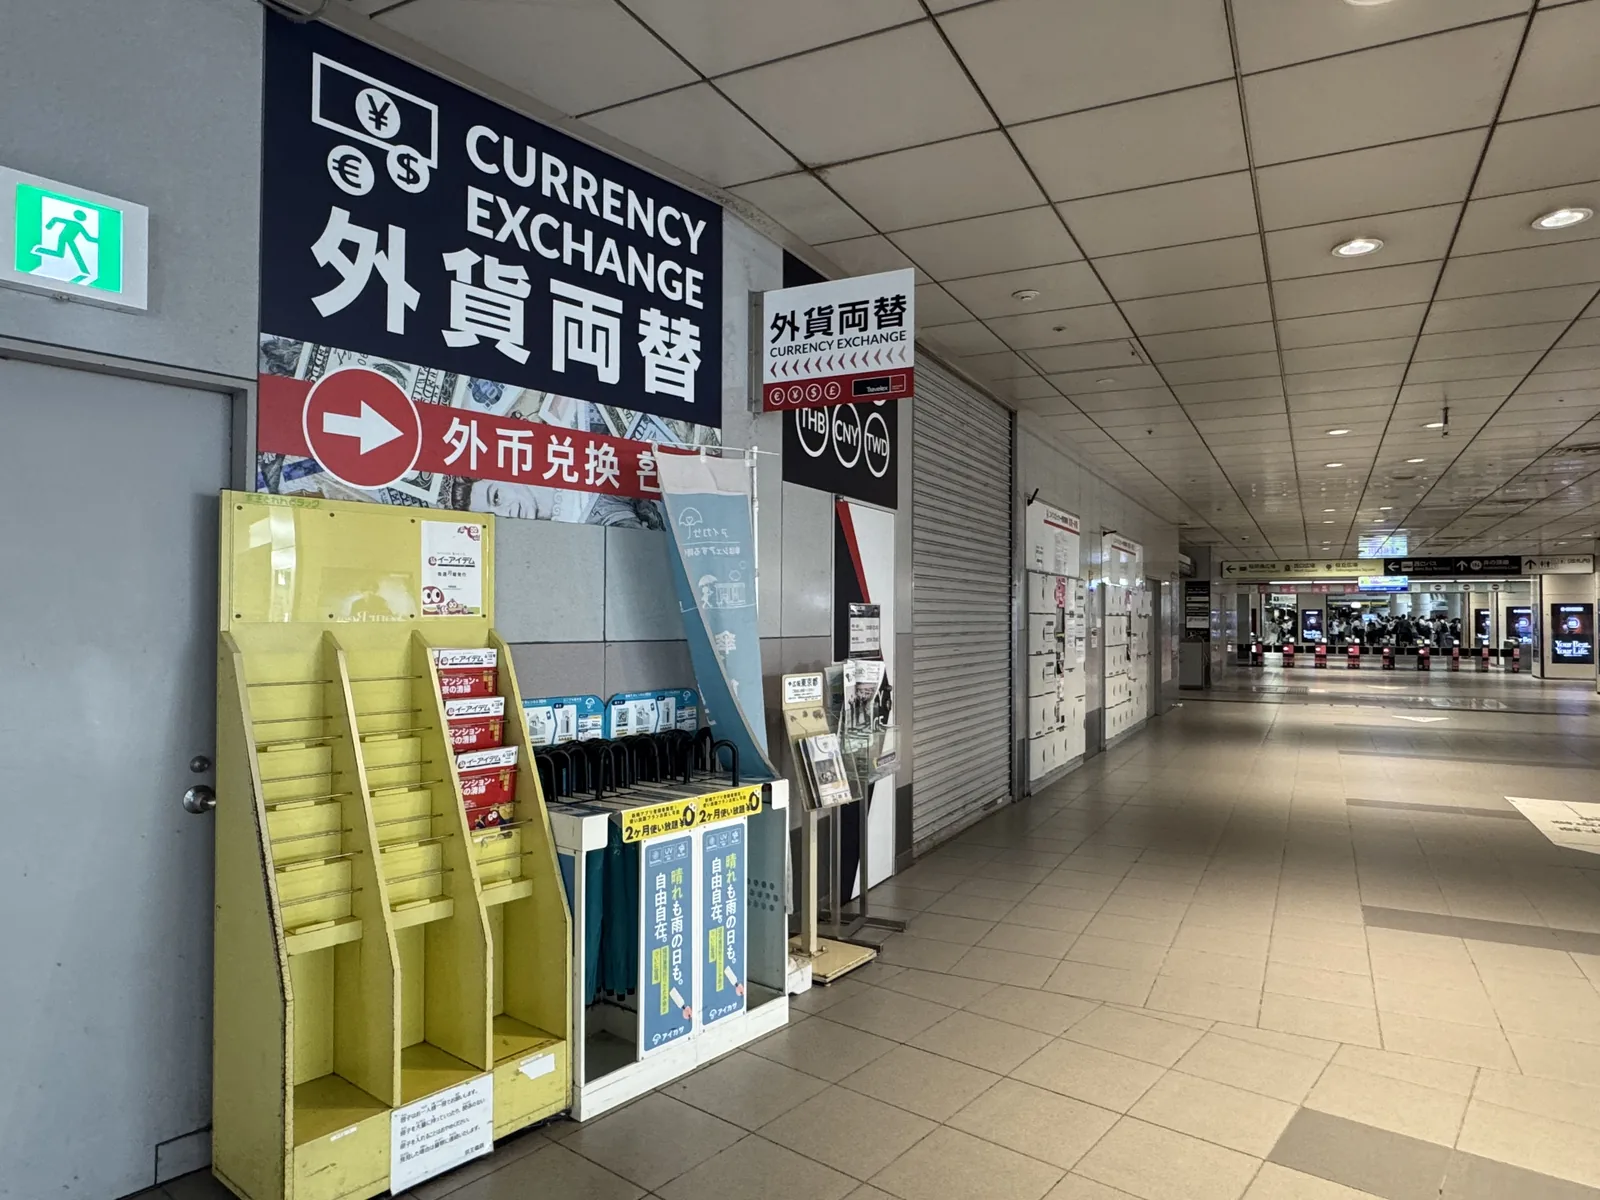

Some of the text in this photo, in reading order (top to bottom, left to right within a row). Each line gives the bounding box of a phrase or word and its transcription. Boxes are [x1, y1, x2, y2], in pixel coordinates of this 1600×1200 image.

[465, 125, 707, 255] CURRENCY
[466, 185, 705, 309] EXCHANGE
[310, 206, 702, 403] 外貨両替
[770, 294, 907, 344] 外貨両替
[770, 330, 907, 358] CURRENCY EXCHANGE
[442, 416, 620, 489] 外币兑换
[801, 407, 888, 457] THB CNY TWD
[438, 556, 476, 565] イーアイデム
[449, 655, 484, 663] イーアイデム
[456, 704, 490, 713] イーアイデム
[466, 755, 501, 765] イーアイデム
[654, 872, 668, 943] 自由自在。
[711, 857, 723, 924] 自由自在。
[725, 853, 737, 964] 晴れも雨の日も。
[670, 867, 684, 986] 晴れも雨の日も。
[717, 1002, 738, 1014] アイカサ
[662, 1026, 685, 1041] アイカサ
